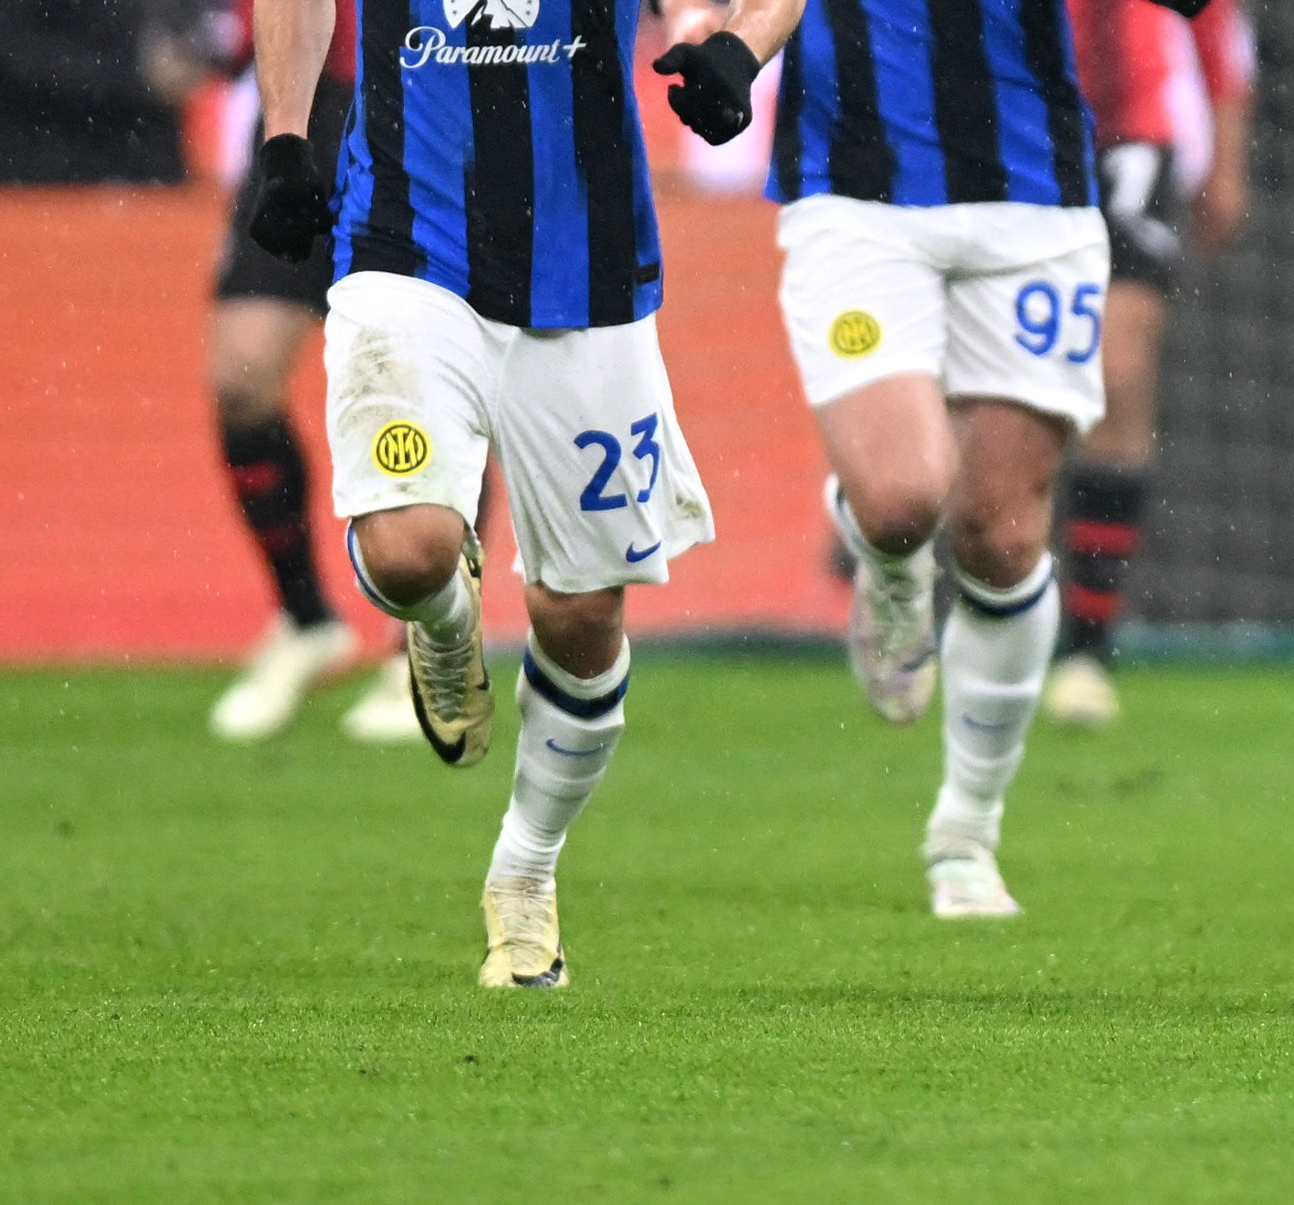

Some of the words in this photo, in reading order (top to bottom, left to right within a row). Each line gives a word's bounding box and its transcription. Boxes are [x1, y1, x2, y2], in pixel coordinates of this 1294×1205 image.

[400, 26, 588, 69] Paramount+
[1014, 280, 1102, 364] 95
[574, 412, 661, 512] 23
